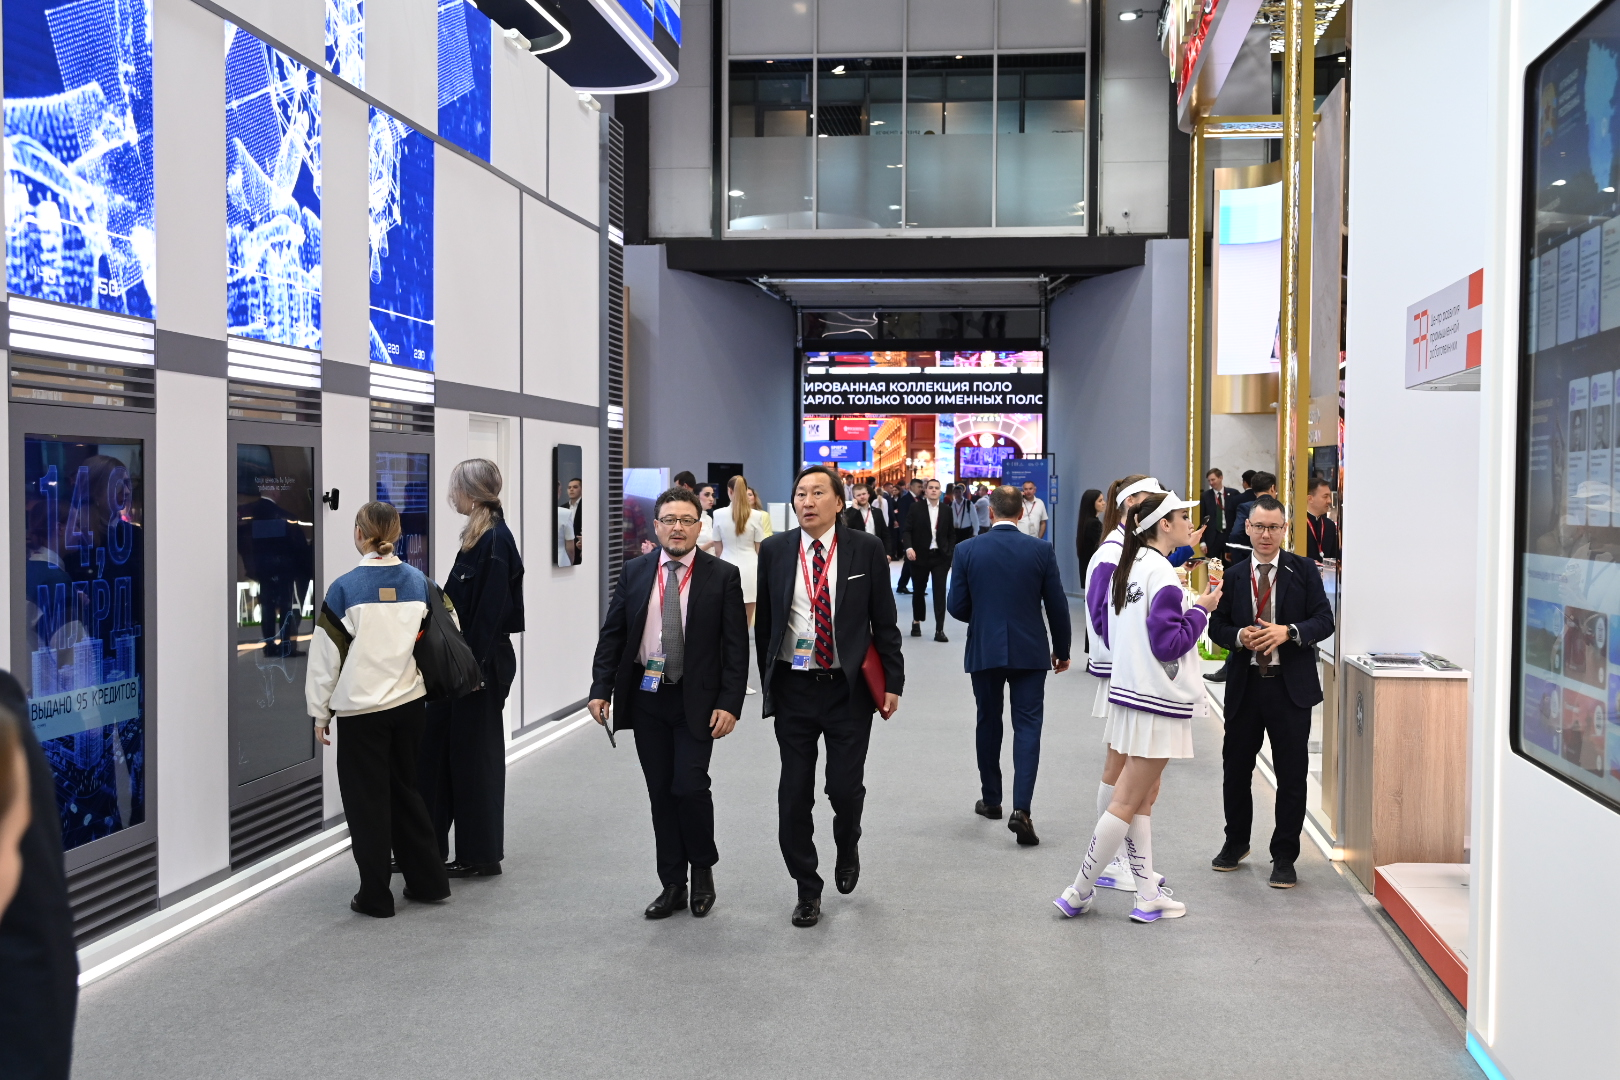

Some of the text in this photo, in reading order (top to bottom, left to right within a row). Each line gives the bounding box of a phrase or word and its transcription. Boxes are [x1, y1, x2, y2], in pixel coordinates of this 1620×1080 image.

[387, 343, 400, 355] 220
[413, 349, 426, 361] 230
[803, 381, 1013, 394] ИРОВАННАЯ КОЛЛЕКЦИЯ ПОЛО
[847, 394, 900, 405] ТОЛЬКО
[902, 394, 932, 405] 1000
[934, 394, 1003, 405] ИМЕННЫХ
[39, 464, 133, 579] 14,8
[31, 681, 137, 722] ВЫДАНО 95 КРЕДИТОВ
